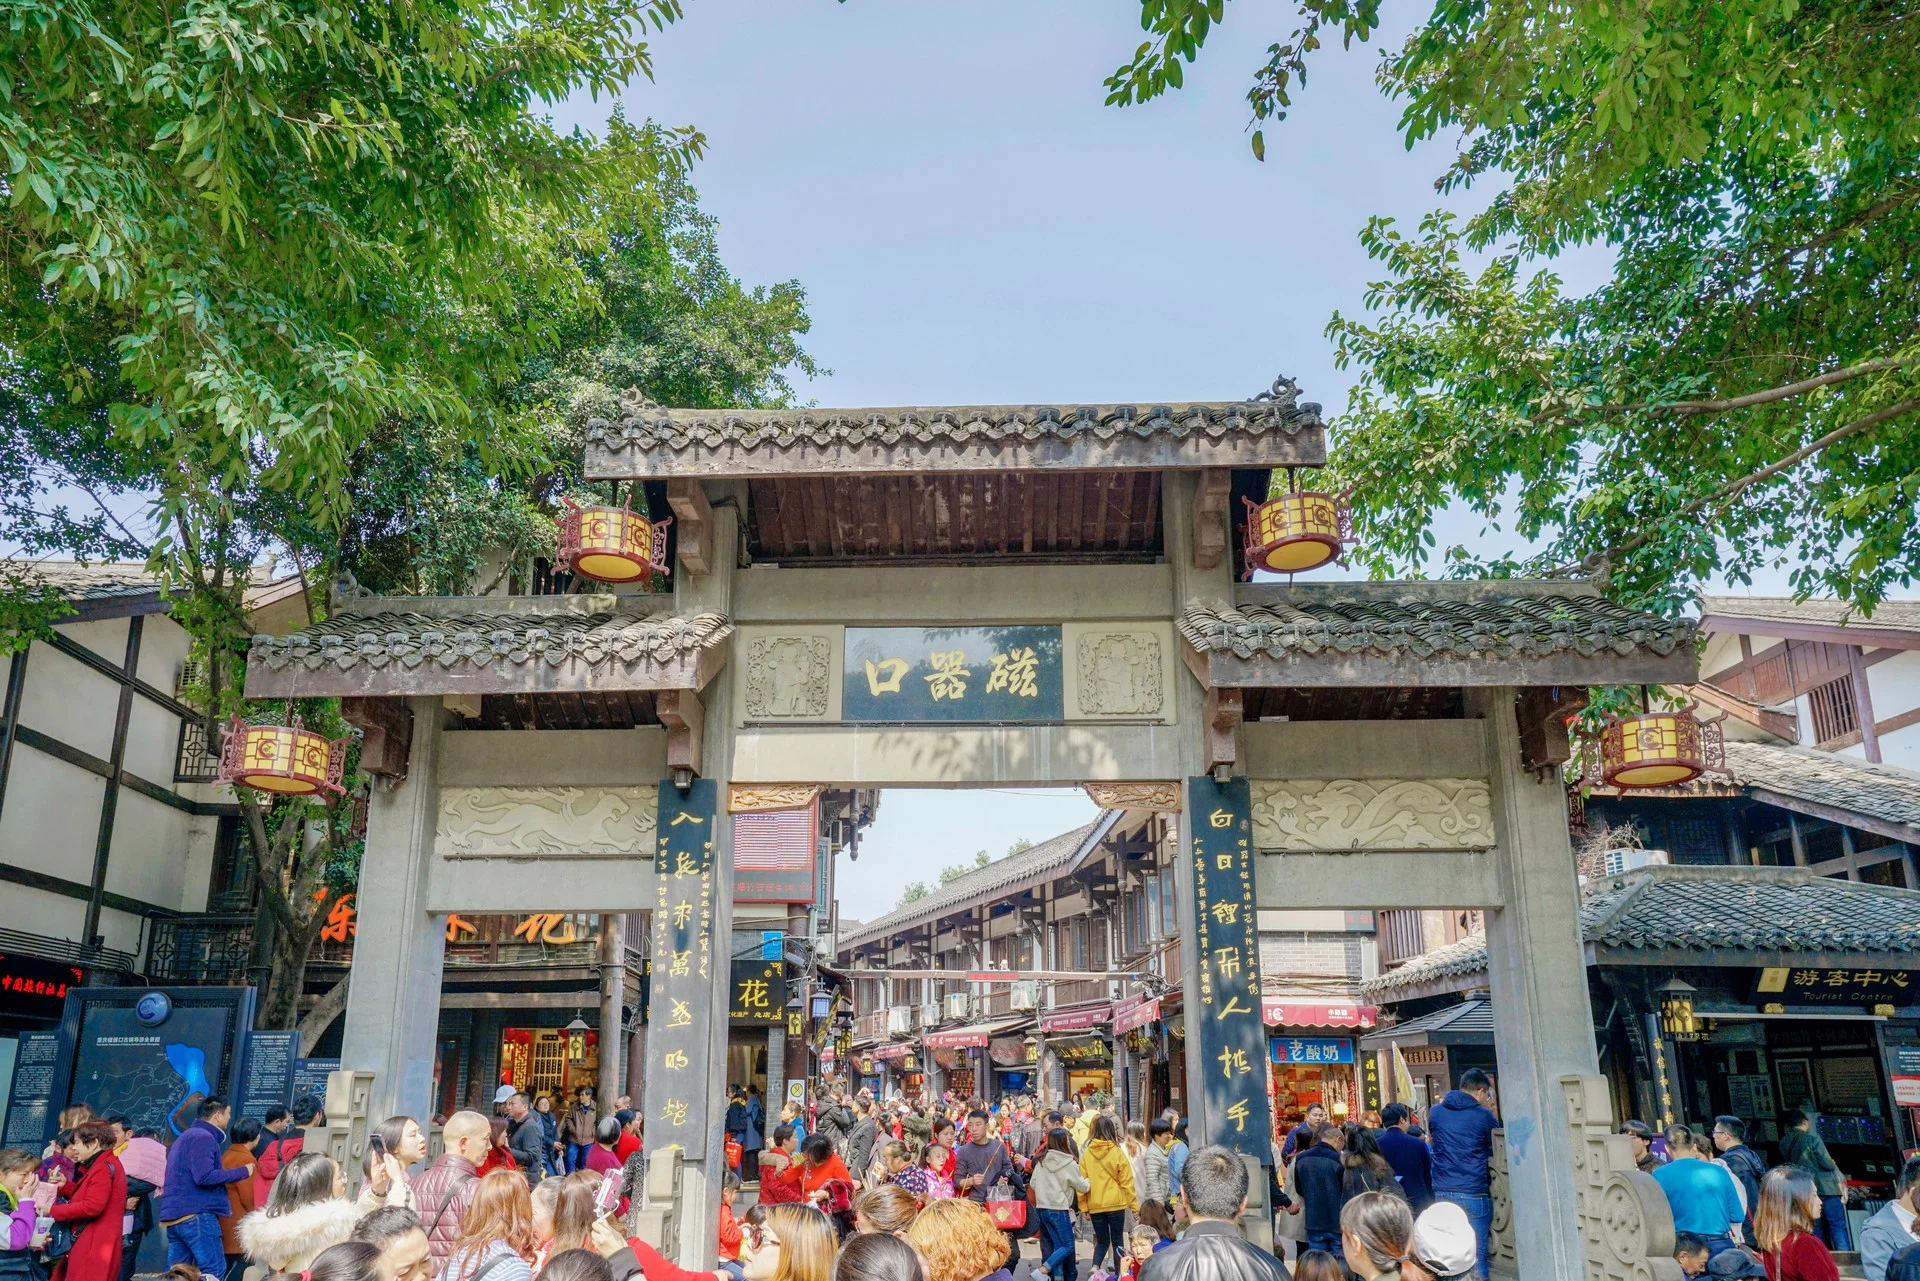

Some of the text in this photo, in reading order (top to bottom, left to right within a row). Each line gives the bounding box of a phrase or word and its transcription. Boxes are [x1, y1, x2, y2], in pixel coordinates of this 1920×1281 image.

[865, 647, 1039, 701] 磁器口
[1793, 969, 1910, 988] 游客中心
[738, 979, 769, 1008] 花
[1803, 991, 1894, 1001] Tourist Centre
[1289, 1039, 1340, 1062] 老酸奶
